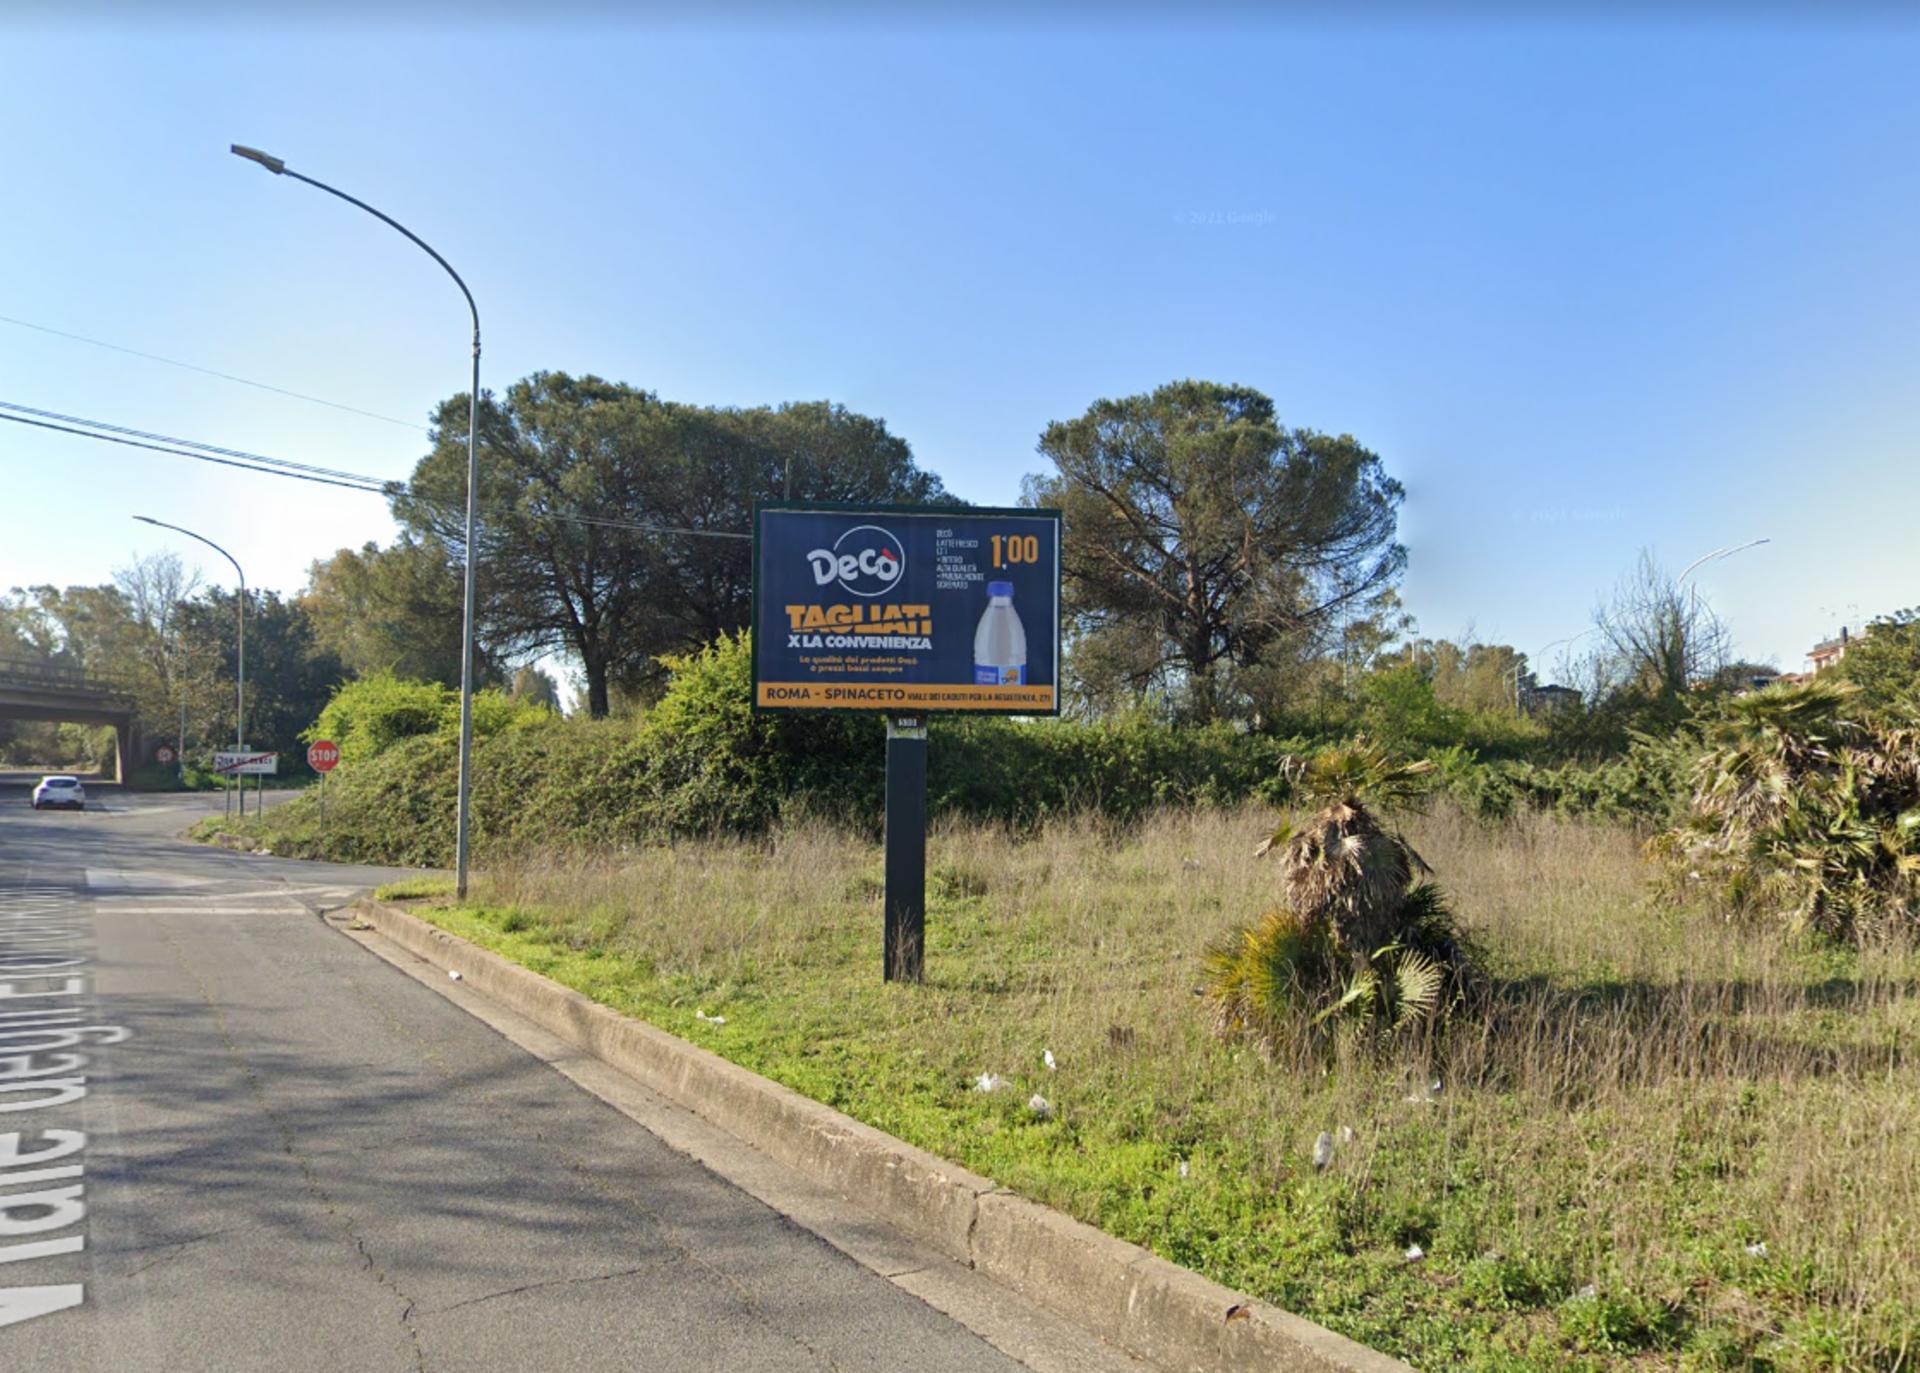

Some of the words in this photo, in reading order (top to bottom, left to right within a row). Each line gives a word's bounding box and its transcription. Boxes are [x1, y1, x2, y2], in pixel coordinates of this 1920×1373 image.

[785, 604, 932, 635] TAGLIATI
[787, 634, 801, 648] X
[802, 635, 823, 648] LA
[825, 636, 933, 649] CONVENIENZA
[766, 688, 811, 700] ROMA
[824, 688, 905, 701] SPINACETO
[311, 750, 338, 761] STOP
